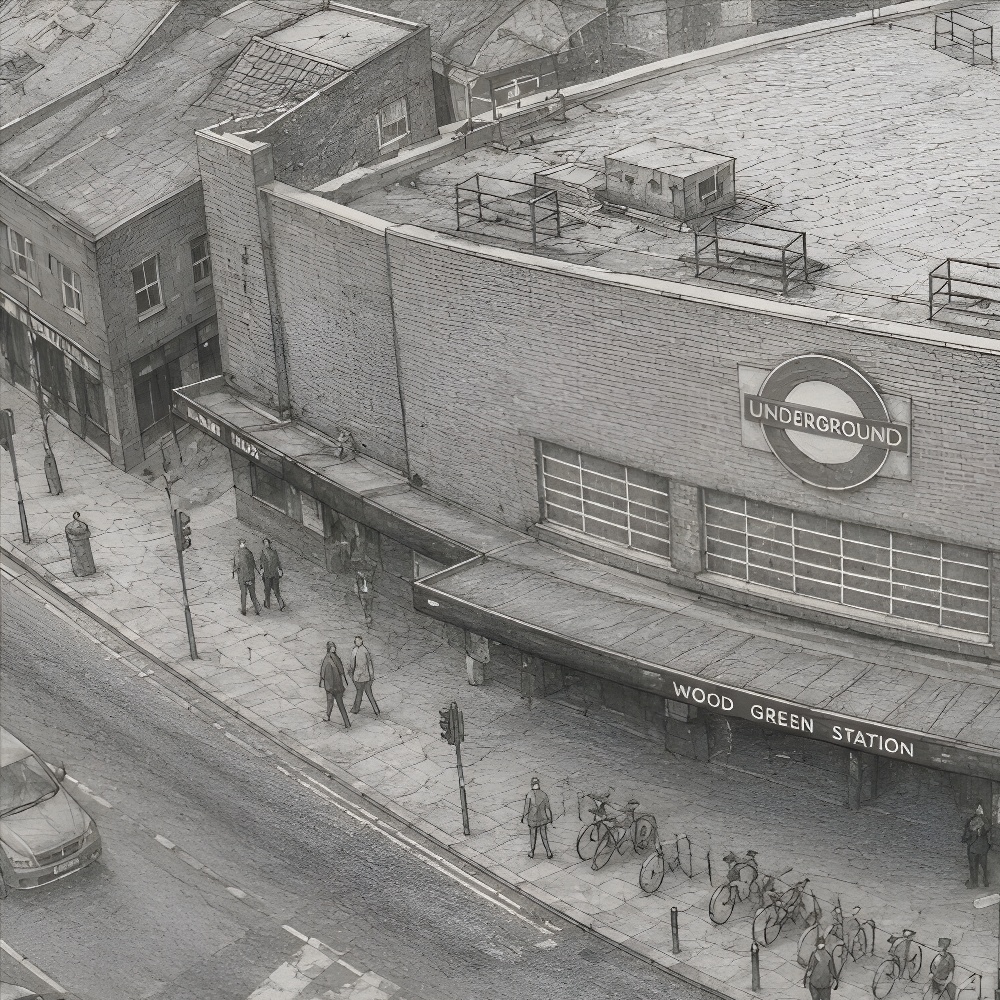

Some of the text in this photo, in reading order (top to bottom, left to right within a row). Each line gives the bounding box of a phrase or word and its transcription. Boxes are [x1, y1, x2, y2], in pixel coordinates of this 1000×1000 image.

[750, 400, 902, 447] UNDERGROUND
[672, 681, 914, 757] WOOD GREEN STATION
